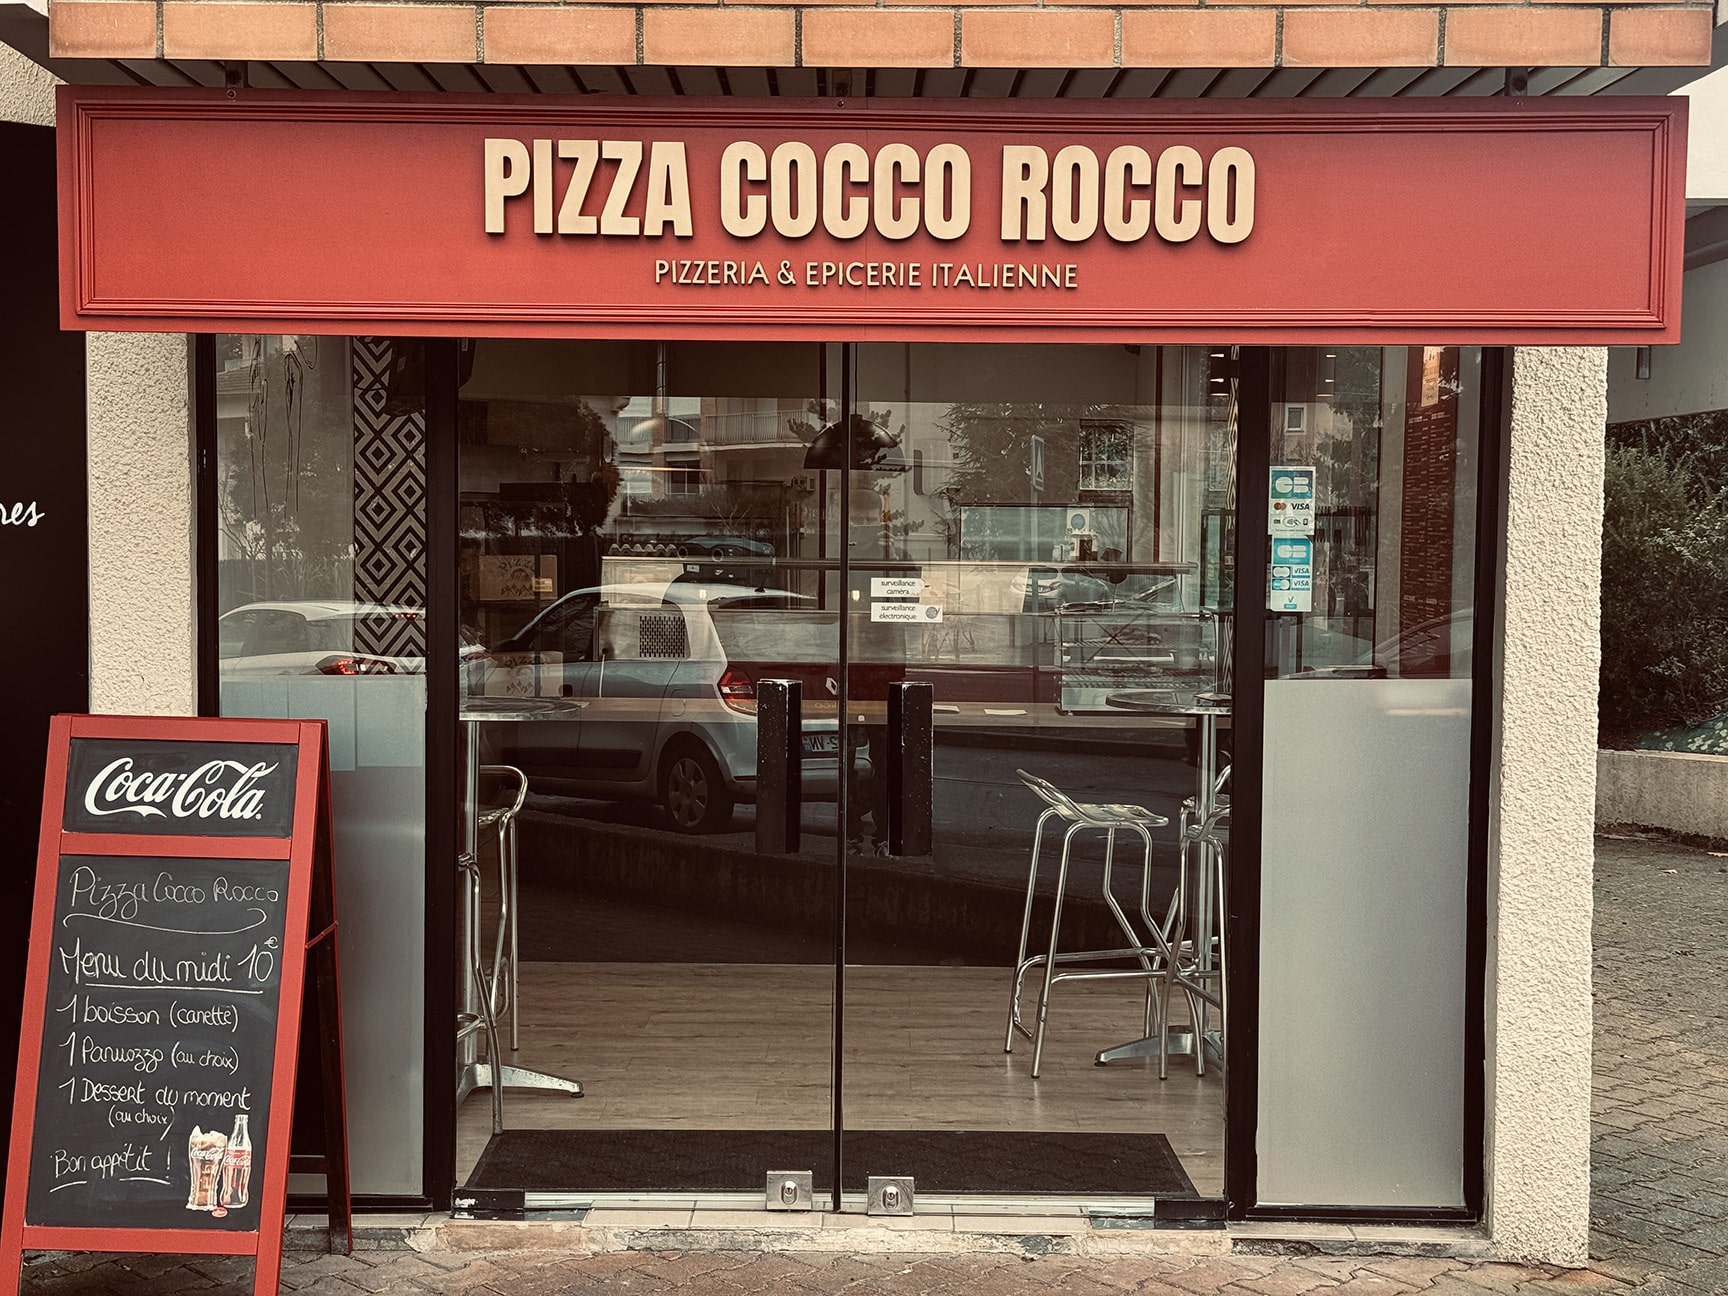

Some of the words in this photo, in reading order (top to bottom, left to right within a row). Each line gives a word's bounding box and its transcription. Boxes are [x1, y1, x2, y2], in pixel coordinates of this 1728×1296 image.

[484, 137, 693, 236] PIZZA
[720, 140, 970, 239] COCCO
[1000, 144, 1256, 243] ROCCO
[655, 260, 770, 286] PIZZERIA
[777, 260, 797, 285] &
[806, 261, 922, 288] EPICERIE
[932, 263, 1079, 289] ITALIENNE
[1291, 502, 1310, 510] VISA
[879, 613, 917, 622] électronique
[84, 757, 279, 820] Coca-Cola
[70, 866, 148, 919] Pizza
[213, 877, 279, 902] Rocco
[59, 937, 127, 984] Menu
[133, 951, 171, 983] du
[177, 952, 232, 983] midi
[56, 994, 77, 1023] 1
[84, 995, 160, 1025] boisson
[170, 1000, 239, 1032] (canette)
[59, 1031, 76, 1066] 1
[171, 1041, 195, 1069] (au
[199, 1046, 239, 1076] choix)
[58, 1076, 76, 1104] 1
[81, 1077, 146, 1105] Dessert
[155, 1085, 179, 1106] du
[183, 1086, 251, 1111] moment
[108, 1104, 132, 1128] (au
[134, 1106, 175, 1141] choix)
[54, 1149, 87, 1178] Bon
[165, 1146, 172, 1179] !
